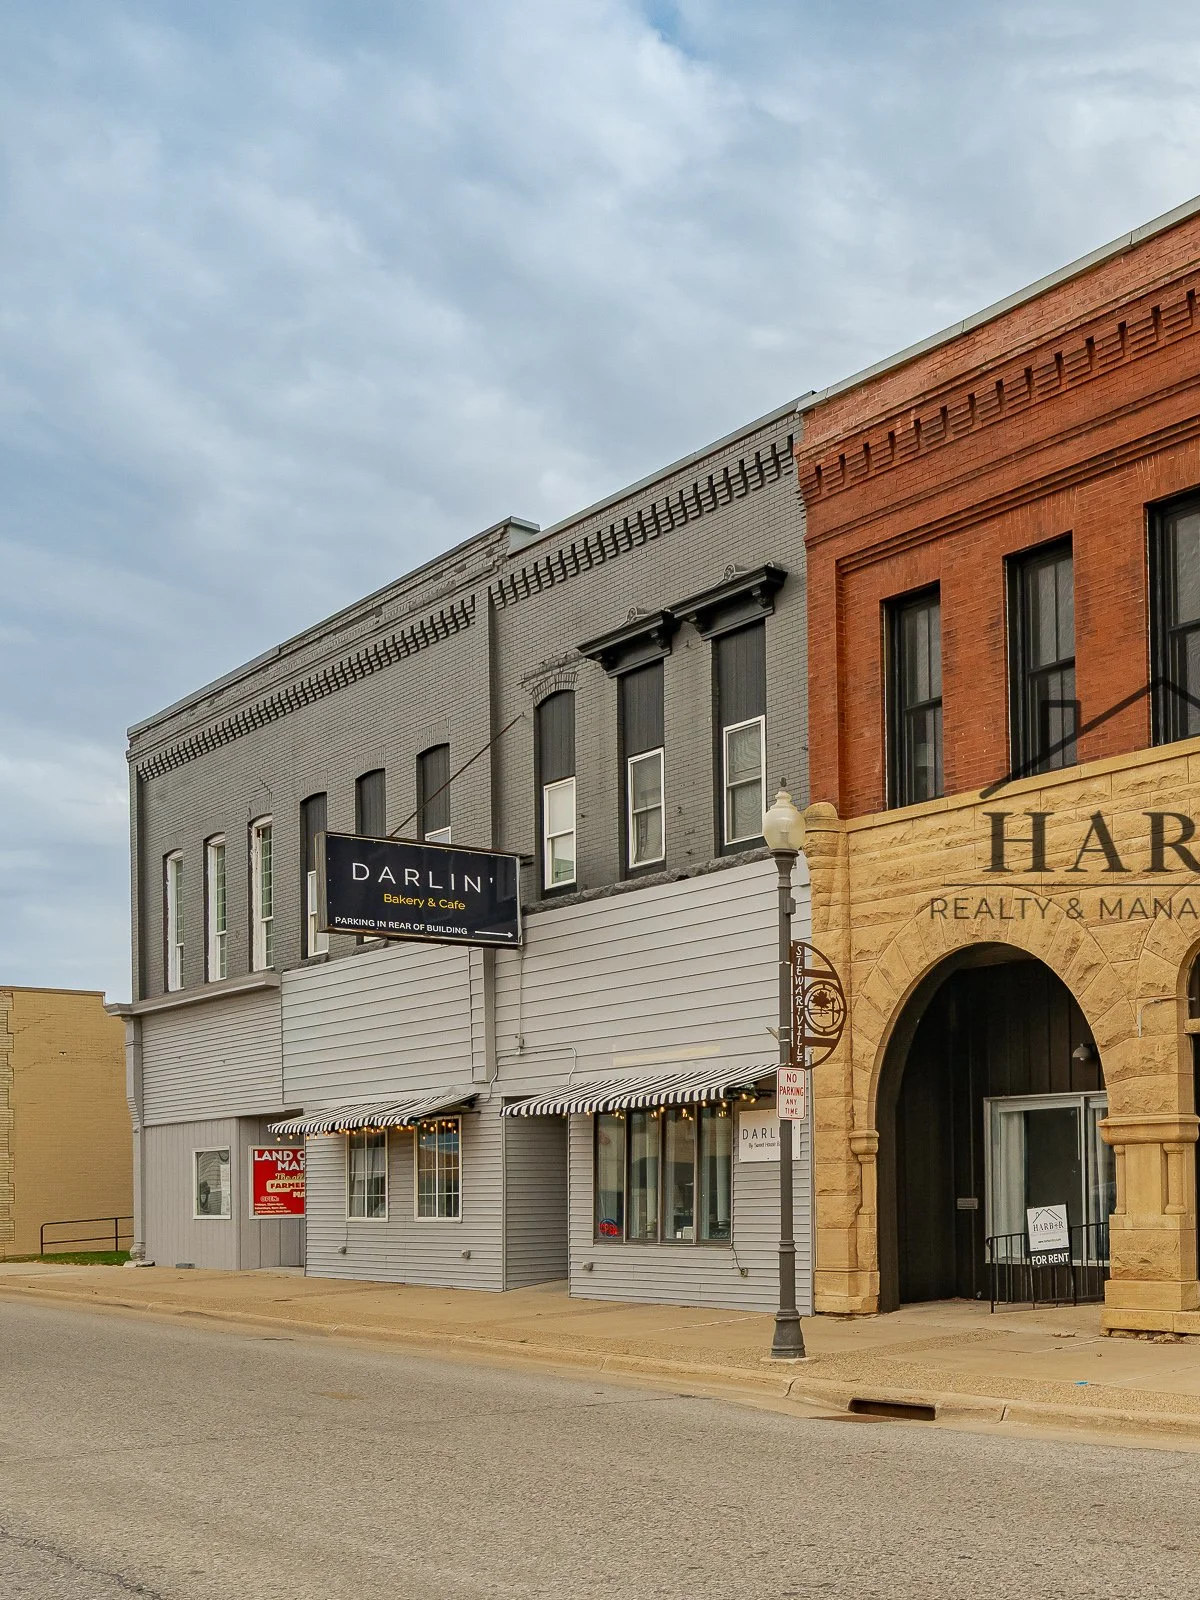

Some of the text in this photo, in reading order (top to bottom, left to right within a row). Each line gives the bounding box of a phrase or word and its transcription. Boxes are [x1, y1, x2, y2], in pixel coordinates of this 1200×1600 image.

[352, 862, 494, 893] DARLIN'
[384, 893, 466, 910] Bakery & Cafe
[335, 916, 375, 927] PARKING
[388, 921, 411, 930] REAR
[413, 923, 425, 931] OF
[426, 924, 468, 935] BUILDING
[786, 1073, 798, 1083] NO
[779, 1085, 804, 1096] PARKING
[785, 1107, 798, 1115] TIME
[254, 1150, 294, 1160] LAND
[1031, 1252, 1069, 1265] FOR RENT
